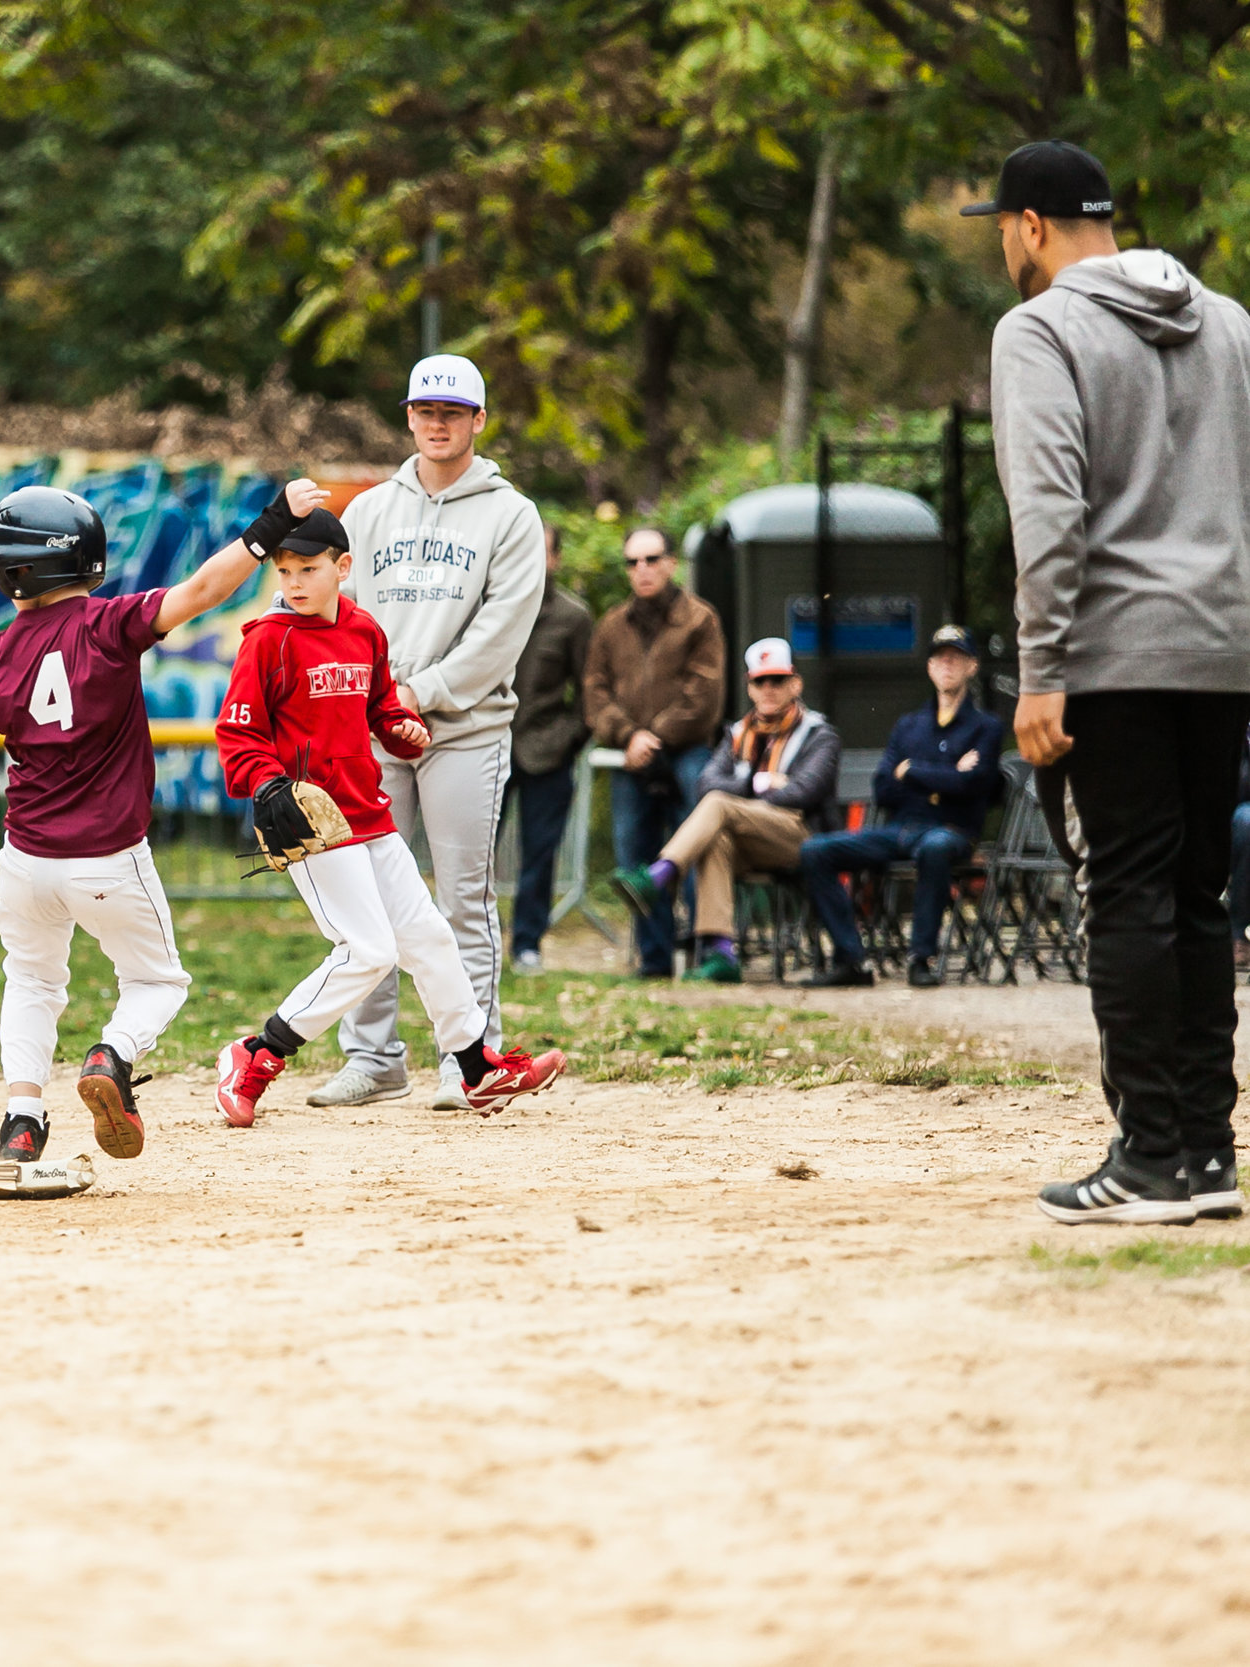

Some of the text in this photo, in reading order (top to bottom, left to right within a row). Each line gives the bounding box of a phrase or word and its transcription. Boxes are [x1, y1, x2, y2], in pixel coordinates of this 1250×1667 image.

[421, 375, 456, 387] NYU
[46, 534, 80, 548] Rawlings
[373, 539, 477, 577] EAST COAST
[408, 568, 434, 583] 2014
[28, 650, 74, 731] 4
[226, 702, 251, 725] 15
